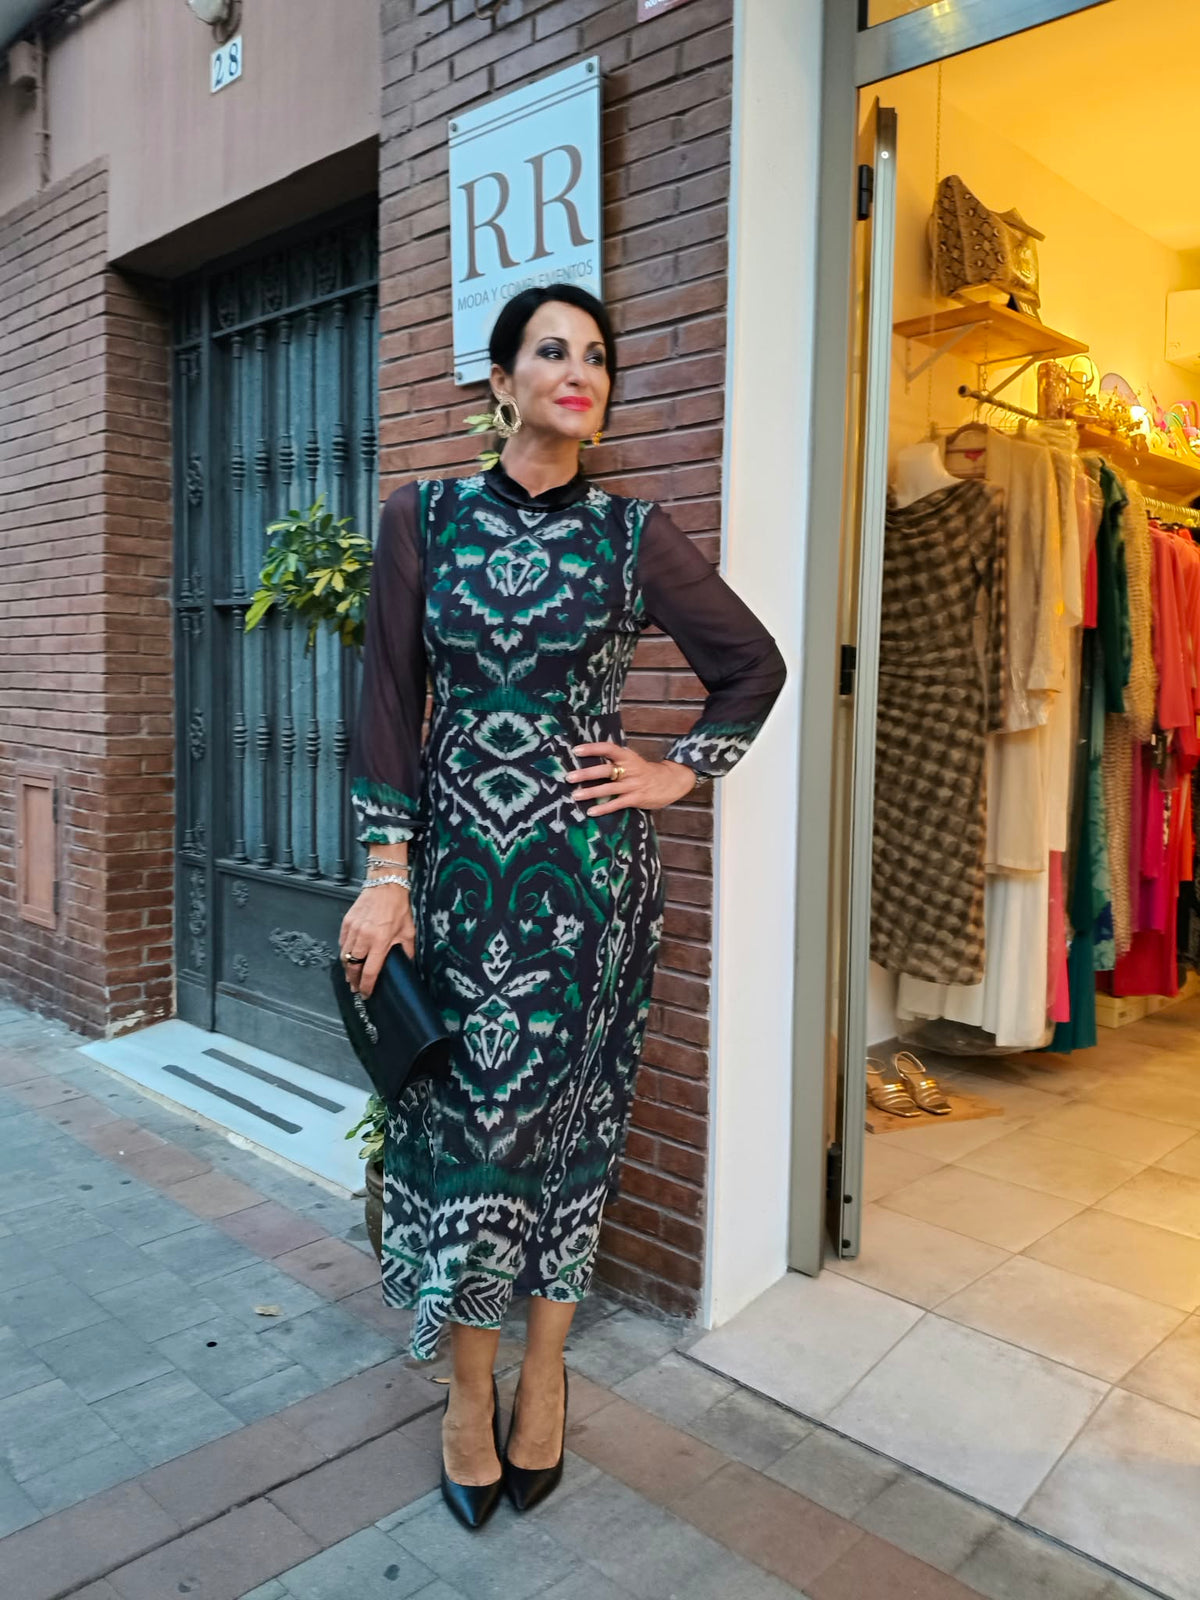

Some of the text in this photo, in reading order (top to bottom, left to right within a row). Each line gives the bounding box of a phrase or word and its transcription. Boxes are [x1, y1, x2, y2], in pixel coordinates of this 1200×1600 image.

[214, 43, 239, 88] 28
[457, 144, 594, 283] RR
[457, 291, 490, 311] MODA
[491, 287, 499, 301] Y
